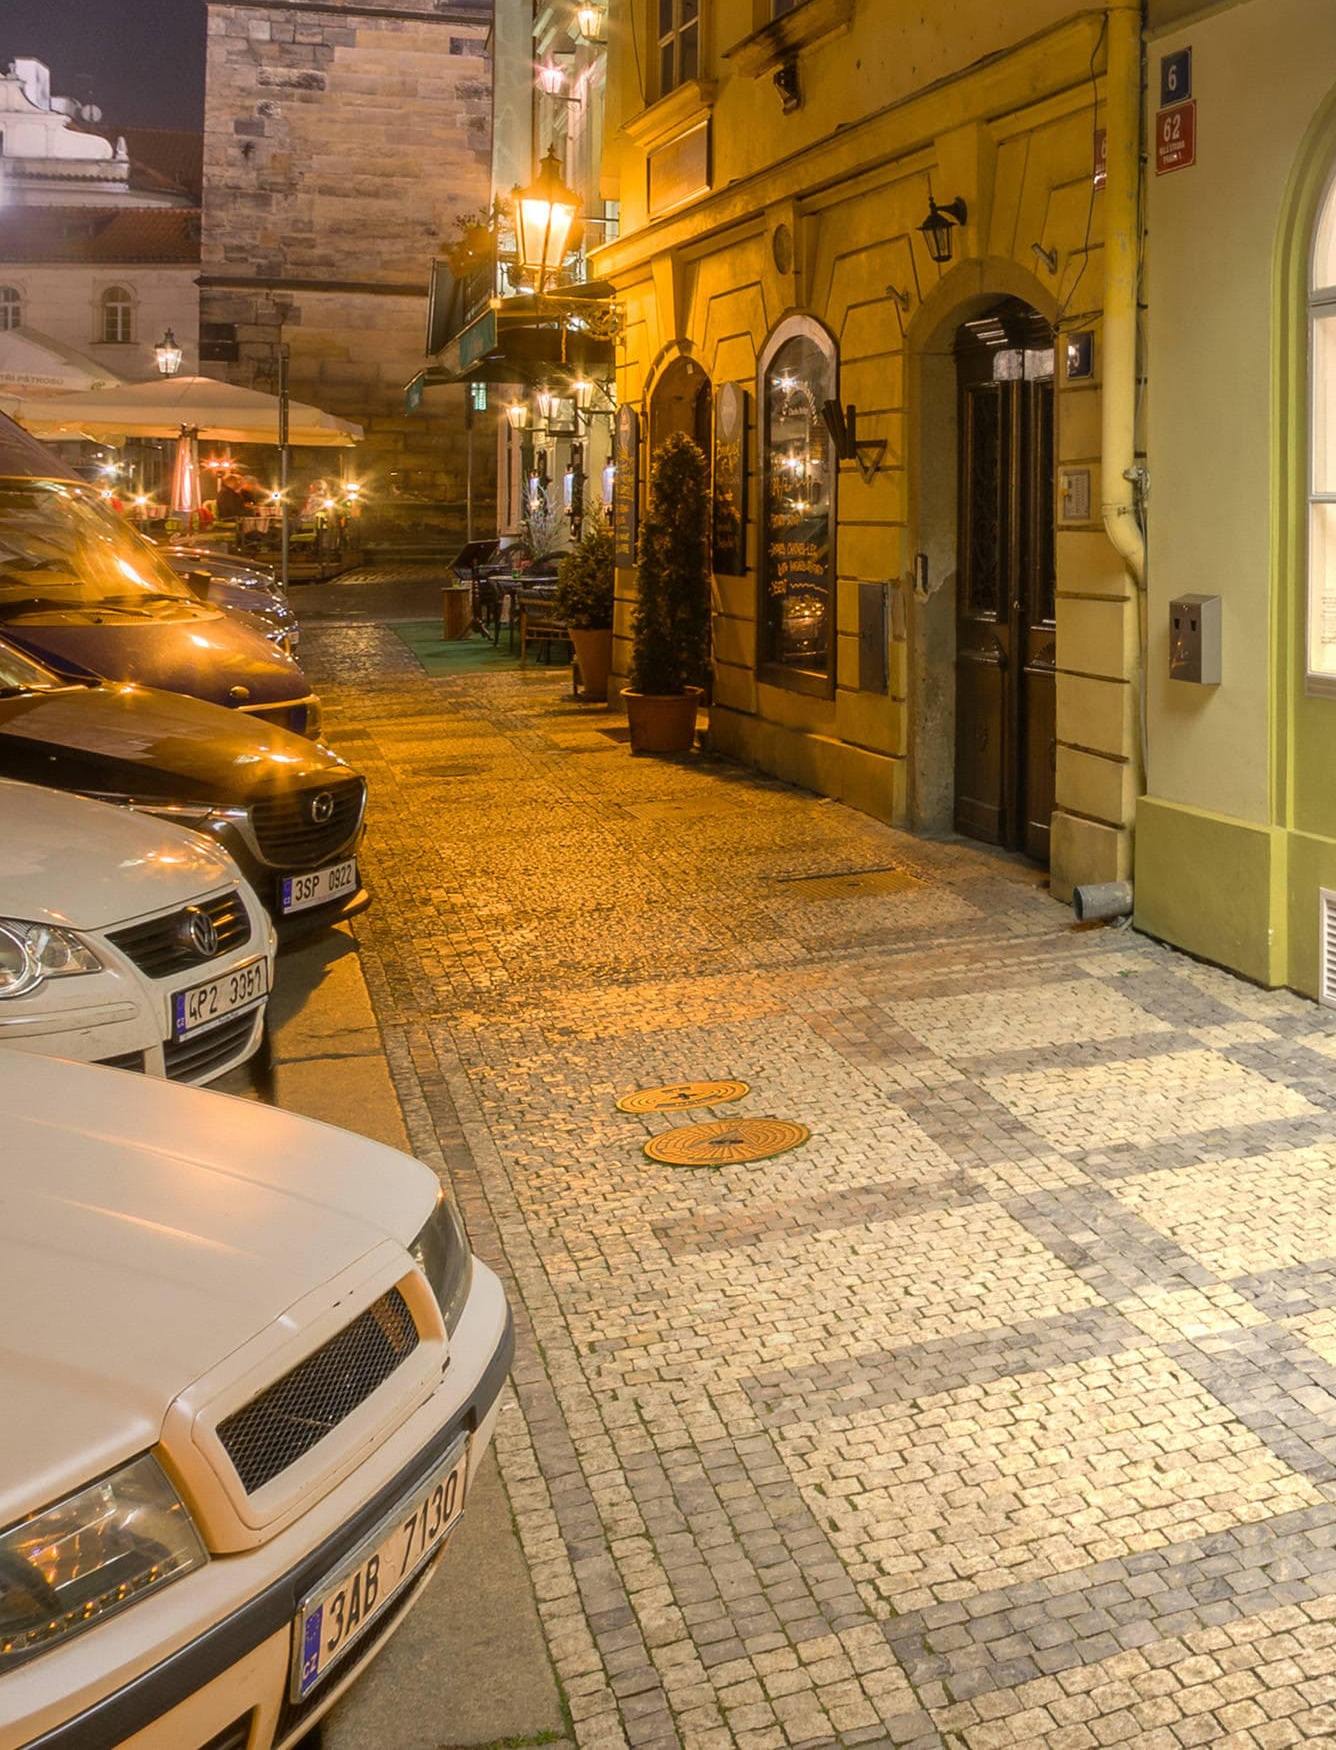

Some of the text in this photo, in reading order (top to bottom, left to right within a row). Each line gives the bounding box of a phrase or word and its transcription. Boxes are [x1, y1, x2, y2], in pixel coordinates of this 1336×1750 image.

[1167, 65, 1178, 91] 6
[1163, 114, 1181, 143] 62
[295, 864, 352, 901] 3SP 0922
[189, 985, 218, 1021] 4P2
[229, 965, 261, 1004] 3351
[328, 1470, 458, 1652] 3AB 7130
[303, 1653, 318, 1677] CZ
